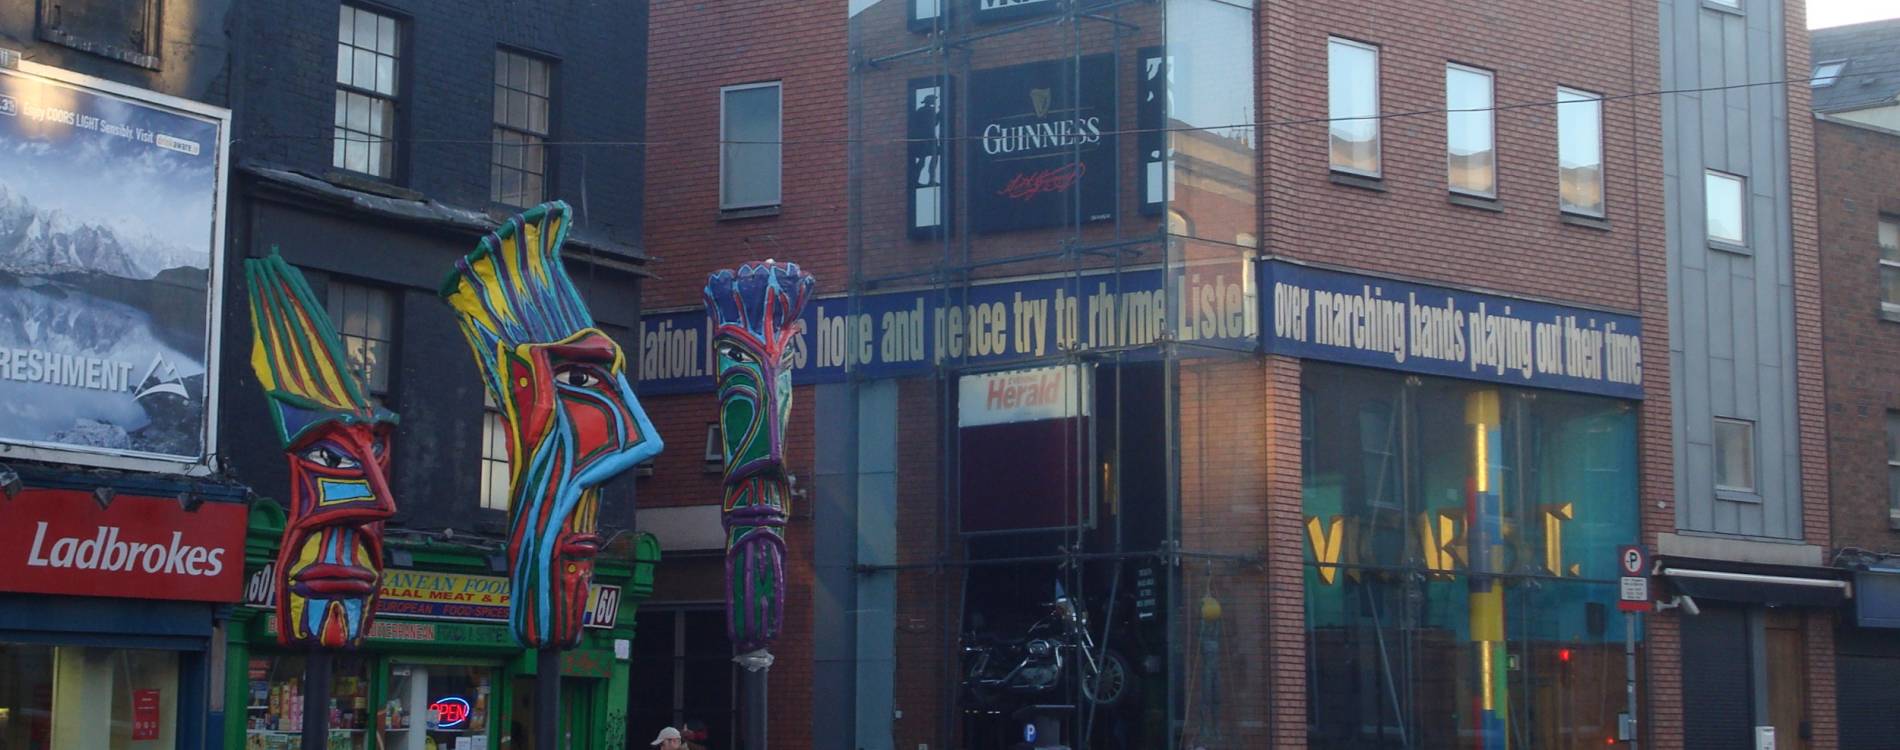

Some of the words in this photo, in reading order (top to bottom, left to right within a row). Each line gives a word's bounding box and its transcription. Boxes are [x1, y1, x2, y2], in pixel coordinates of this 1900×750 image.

[46, 107, 75, 126] COORS
[76, 113, 99, 132] LIGHT
[100, 119, 134, 142] Sensibly.
[136, 127, 154, 144] Visit
[983, 116, 1100, 155] GUINNESS
[817, 306, 872, 373] hope
[882, 298, 925, 362] and
[934, 301, 1006, 366] peace
[1013, 291, 1047, 356] try
[1088, 282, 1166, 348] rhyme
[1274, 281, 1309, 342] over
[1315, 285, 1405, 364] marching
[1409, 293, 1465, 362] bands
[1469, 302, 1532, 379] playing
[1536, 315, 1562, 376] out
[1565, 315, 1603, 381] their
[1606, 321, 1641, 386] time
[987, 373, 1062, 411] Herald
[27, 521, 225, 577] Ladbrokes
[250, 563, 272, 602] 60
[430, 590, 475, 602] MEAT
[481, 593, 492, 603] &
[596, 589, 617, 624] 60
[429, 703, 467, 722] OPEN
[1026, 723, 1036, 742] P
